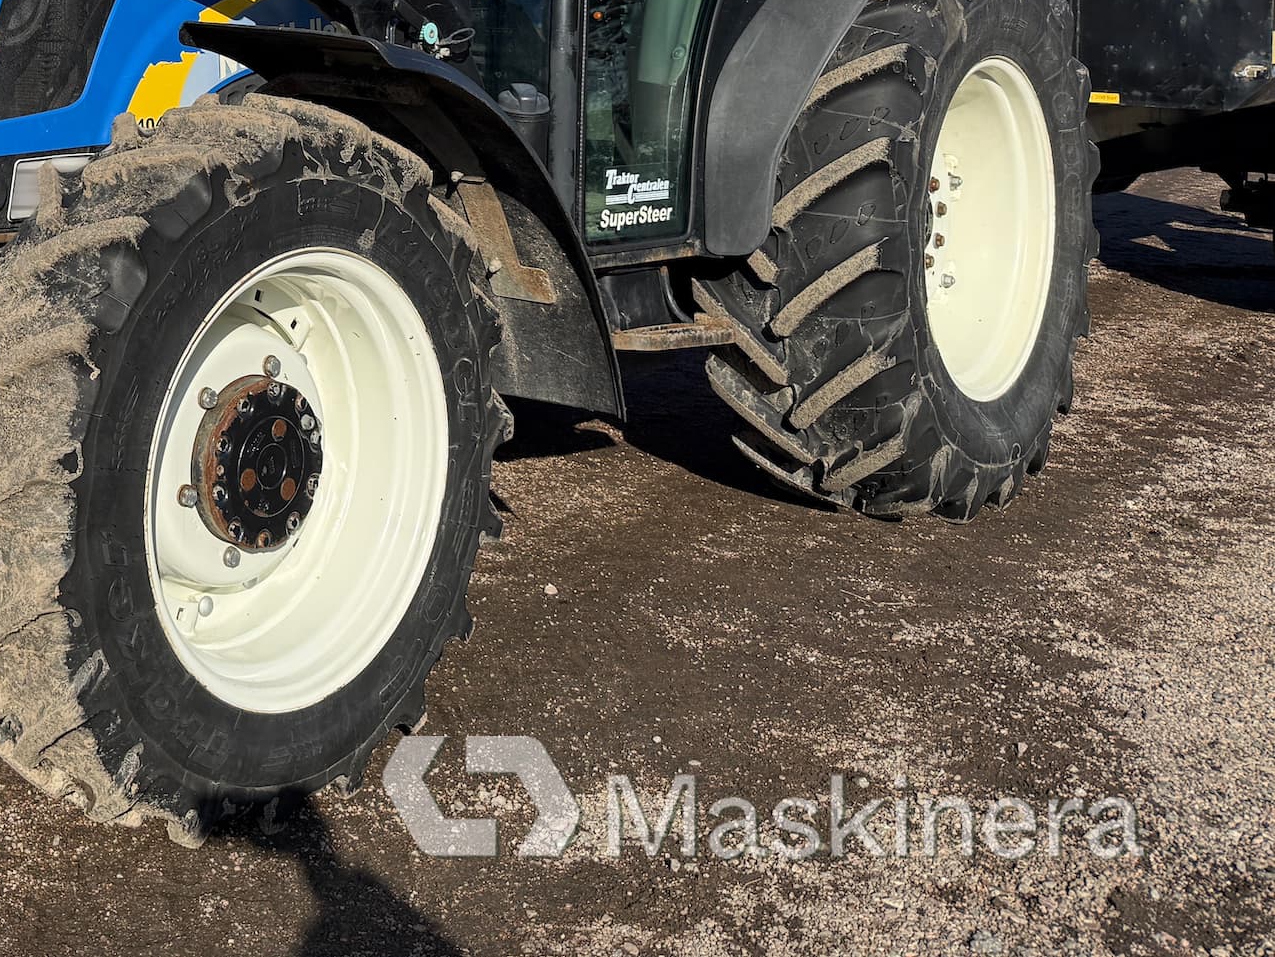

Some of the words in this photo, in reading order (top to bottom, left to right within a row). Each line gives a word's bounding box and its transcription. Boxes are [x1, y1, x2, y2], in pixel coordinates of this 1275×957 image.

[605, 169, 640, 190] Traktor
[627, 178, 670, 205] Centralen
[600, 205, 673, 231] SuperSteer
